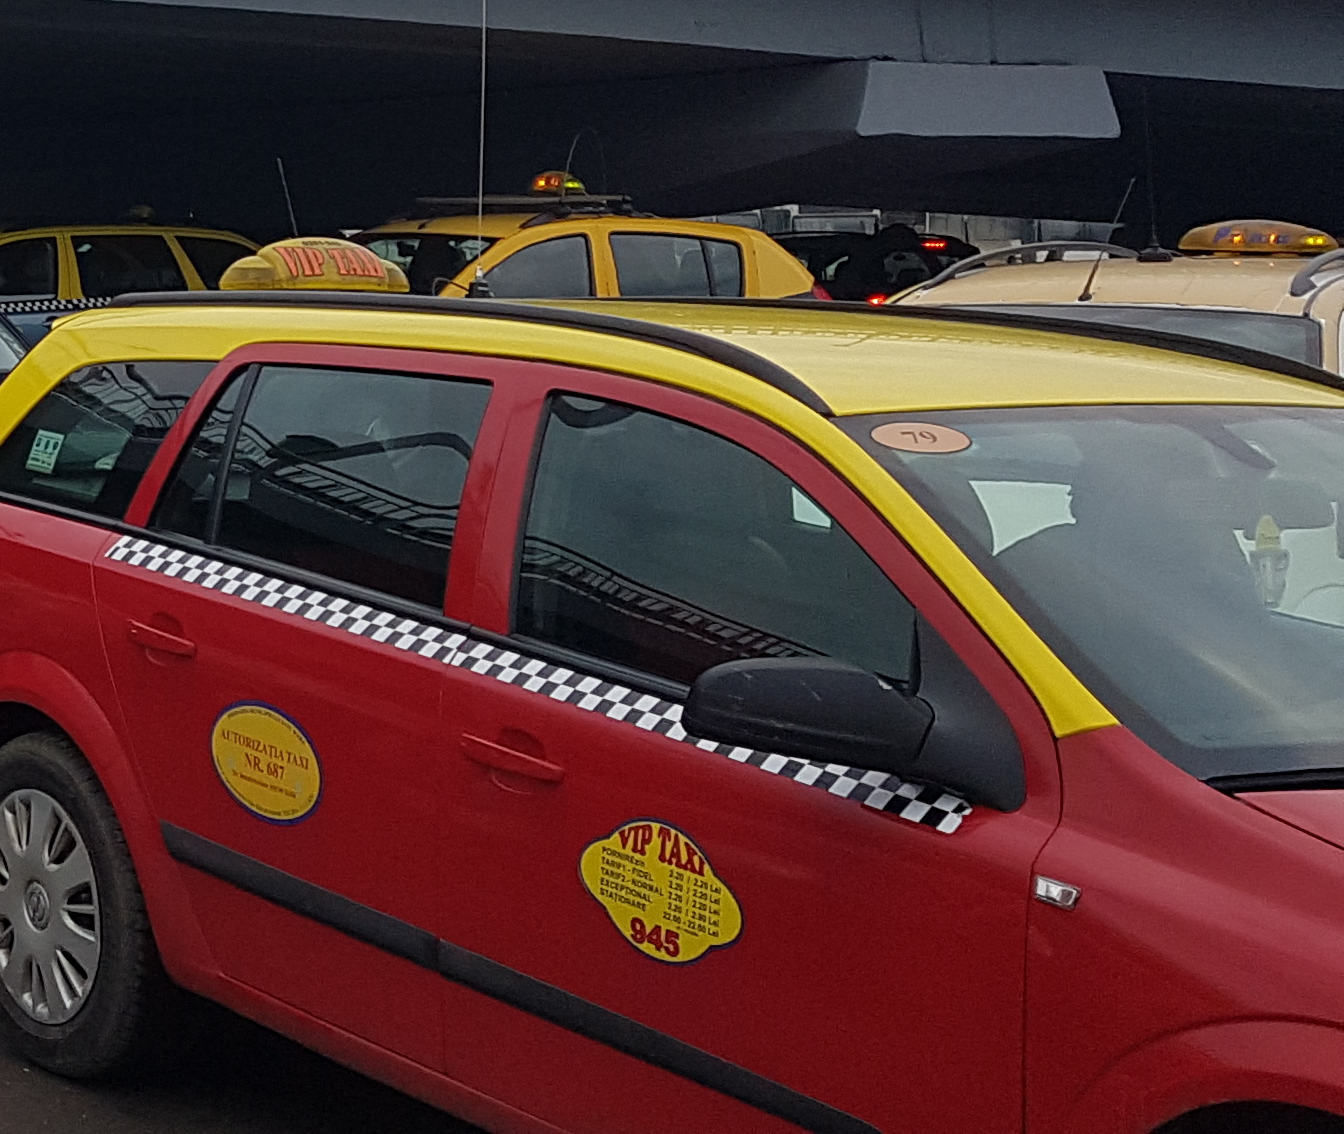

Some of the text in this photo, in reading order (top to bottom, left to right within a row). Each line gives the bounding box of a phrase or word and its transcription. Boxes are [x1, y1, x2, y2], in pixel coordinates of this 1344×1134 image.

[274, 246, 325, 277] VIP
[267, 761, 285, 780] 687
[286, 751, 309, 770] TAXI
[618, 824, 706, 877] VIP TAXI
[630, 917, 680, 957] 945
